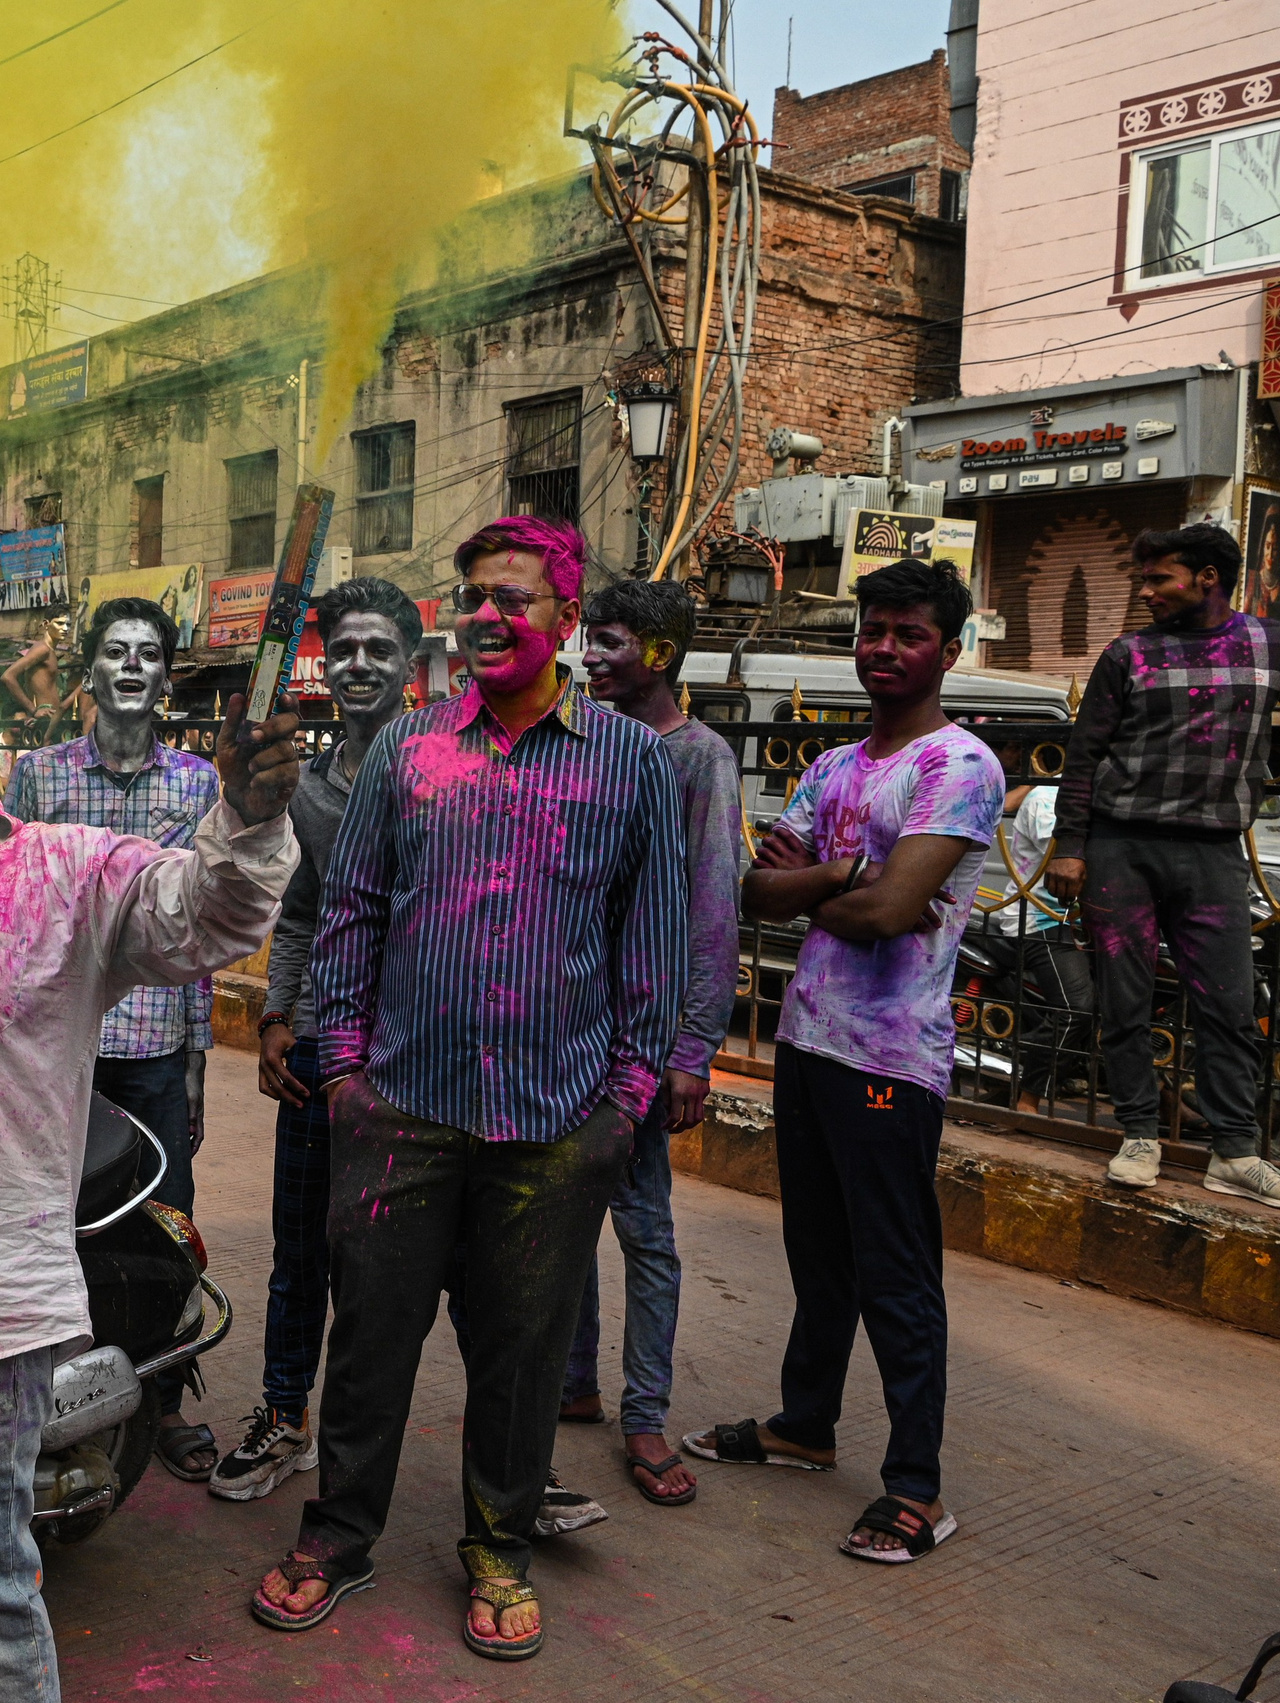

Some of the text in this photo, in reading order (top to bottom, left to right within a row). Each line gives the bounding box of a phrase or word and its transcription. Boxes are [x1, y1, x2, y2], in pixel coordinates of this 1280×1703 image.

[961, 423, 1127, 457] Zoom Travels
[301, 499, 333, 596] SMOKE
[862, 547, 902, 558] AADHAAR
[220, 585, 252, 602] GOVIND
[270, 599, 310, 718] FOUNT
